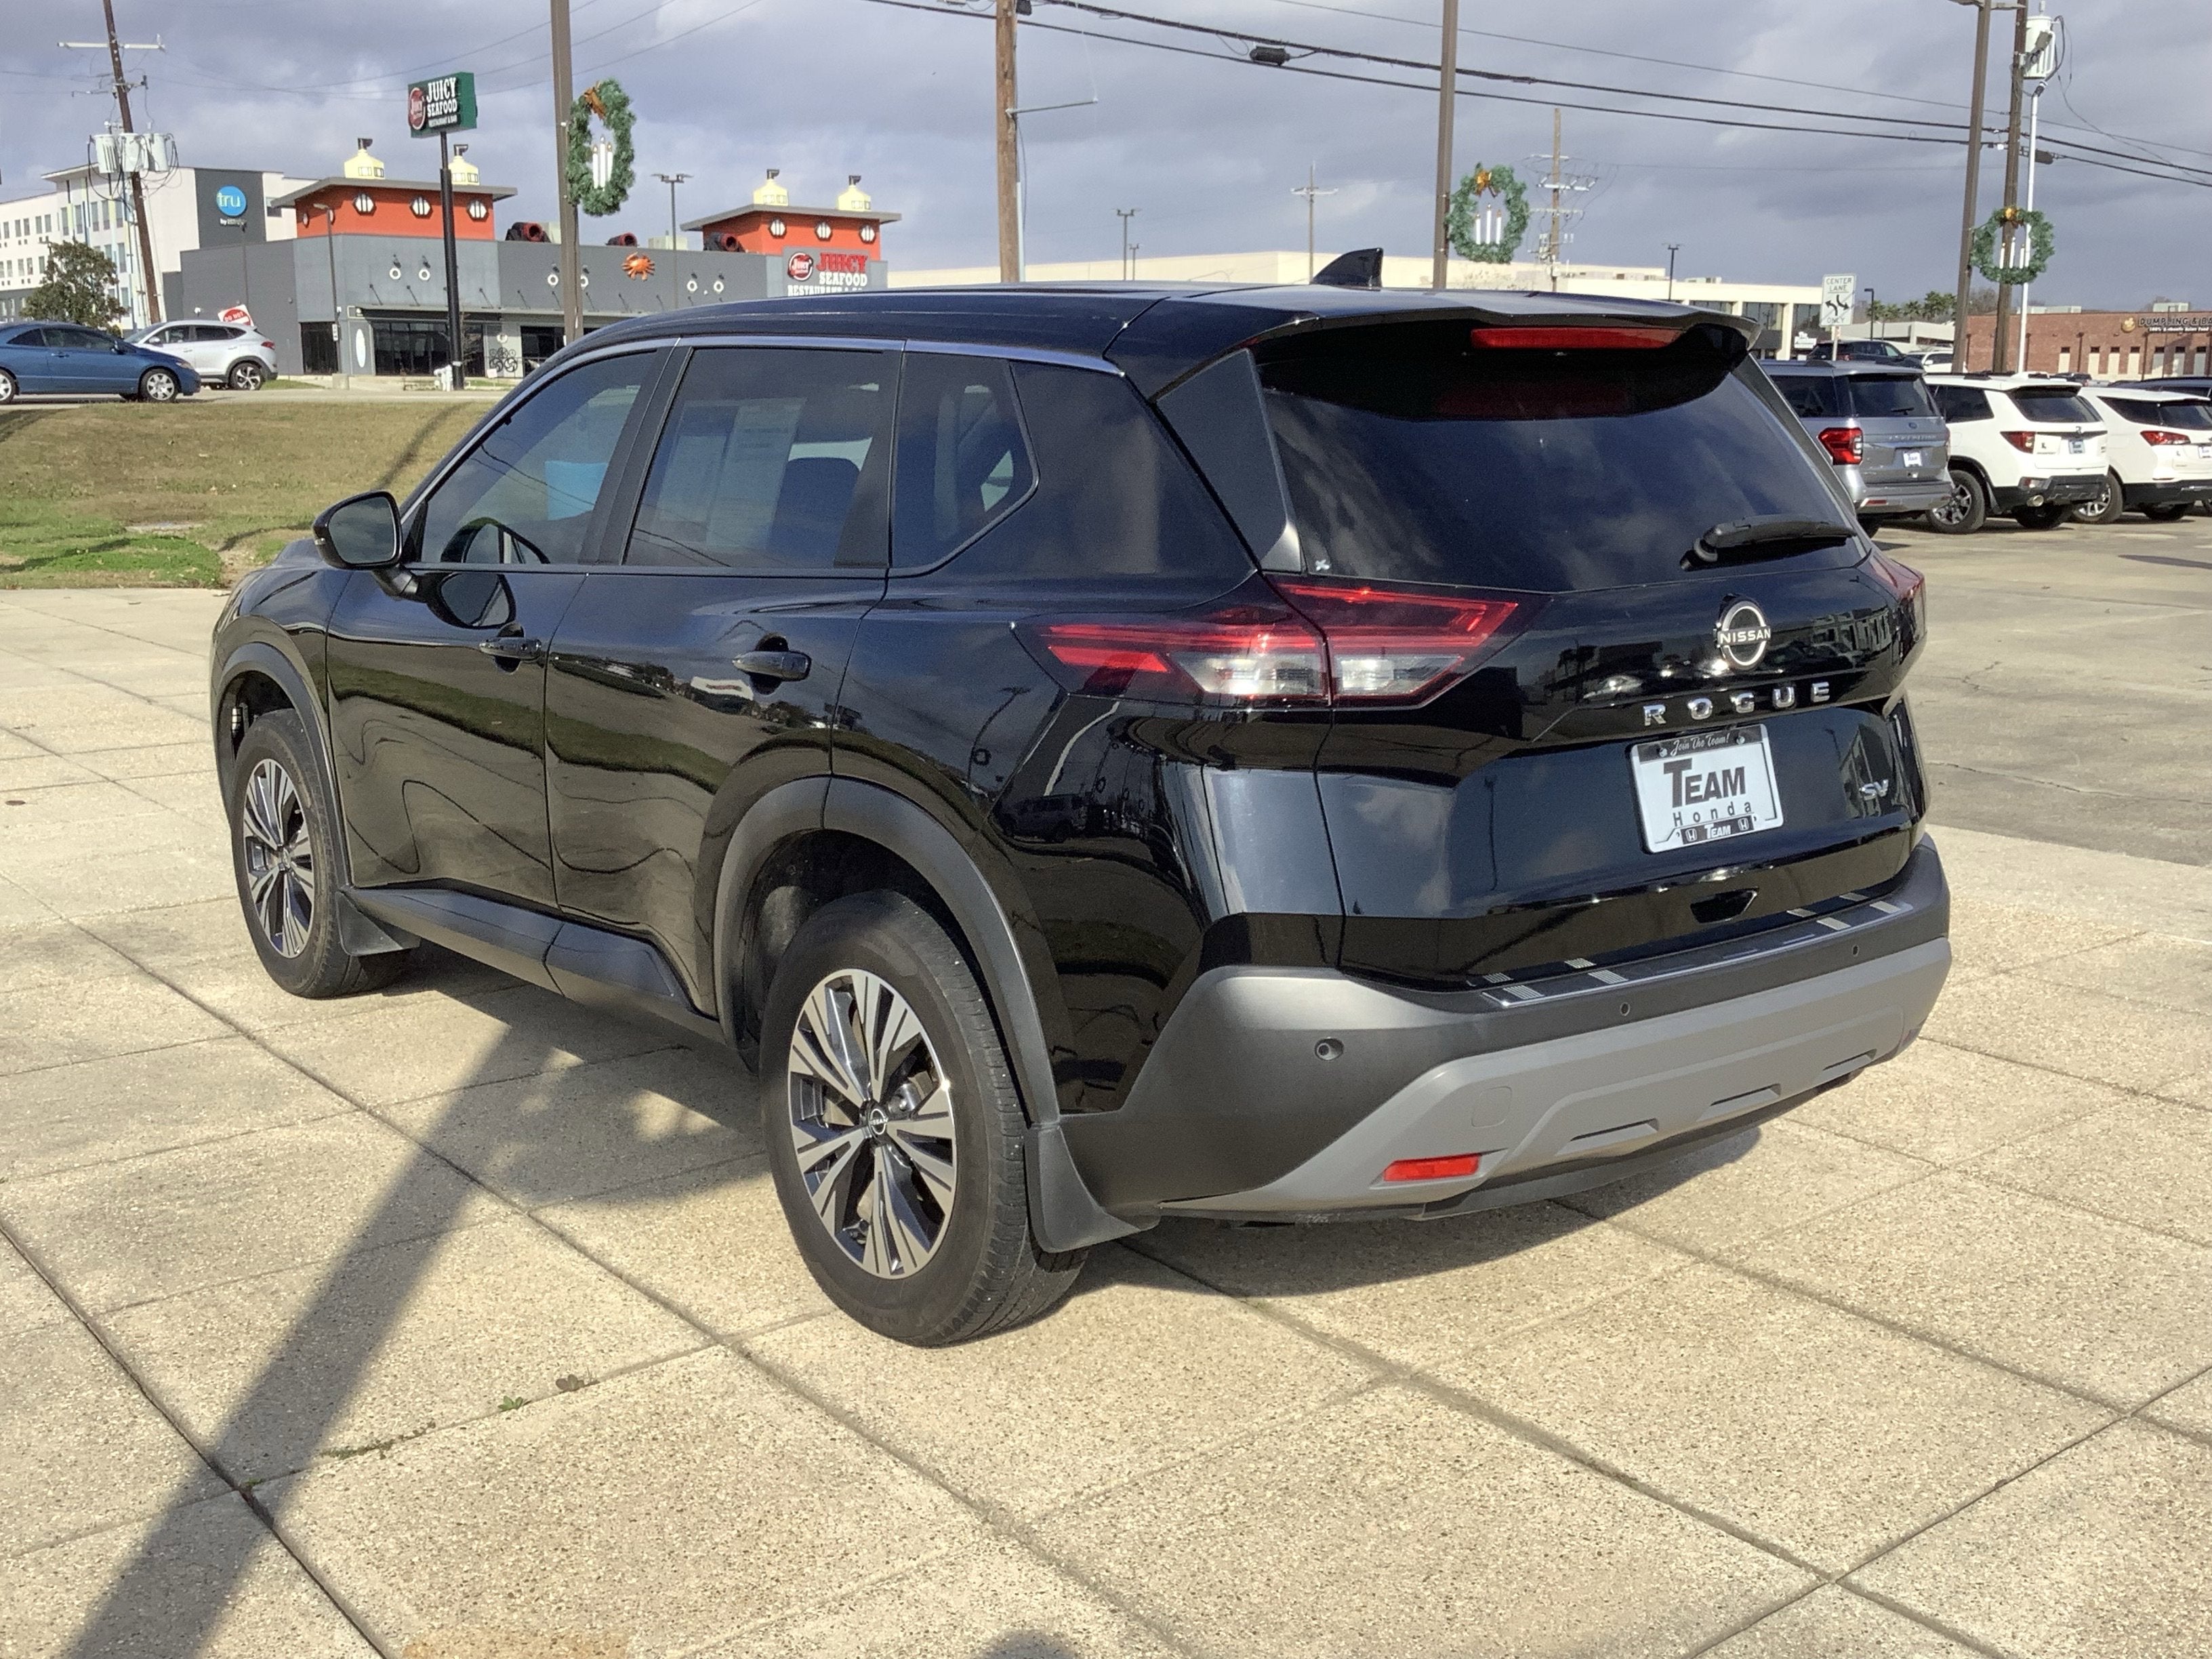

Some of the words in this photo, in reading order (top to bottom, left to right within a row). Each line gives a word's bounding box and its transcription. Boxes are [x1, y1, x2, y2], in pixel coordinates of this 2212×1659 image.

[426, 77, 457, 103] JUICY
[427, 98, 458, 118] SEAFOOD
[217, 192, 241, 207] tru
[817, 252, 869, 274] JUICY
[819, 271, 868, 287] SEAFOOD
[1719, 628, 1771, 644] NISSAN
[1643, 681, 1830, 726] ROGUE
[1690, 736, 1705, 750] The
[1859, 779, 1889, 800] SV
[1673, 801, 1752, 827] Honda
